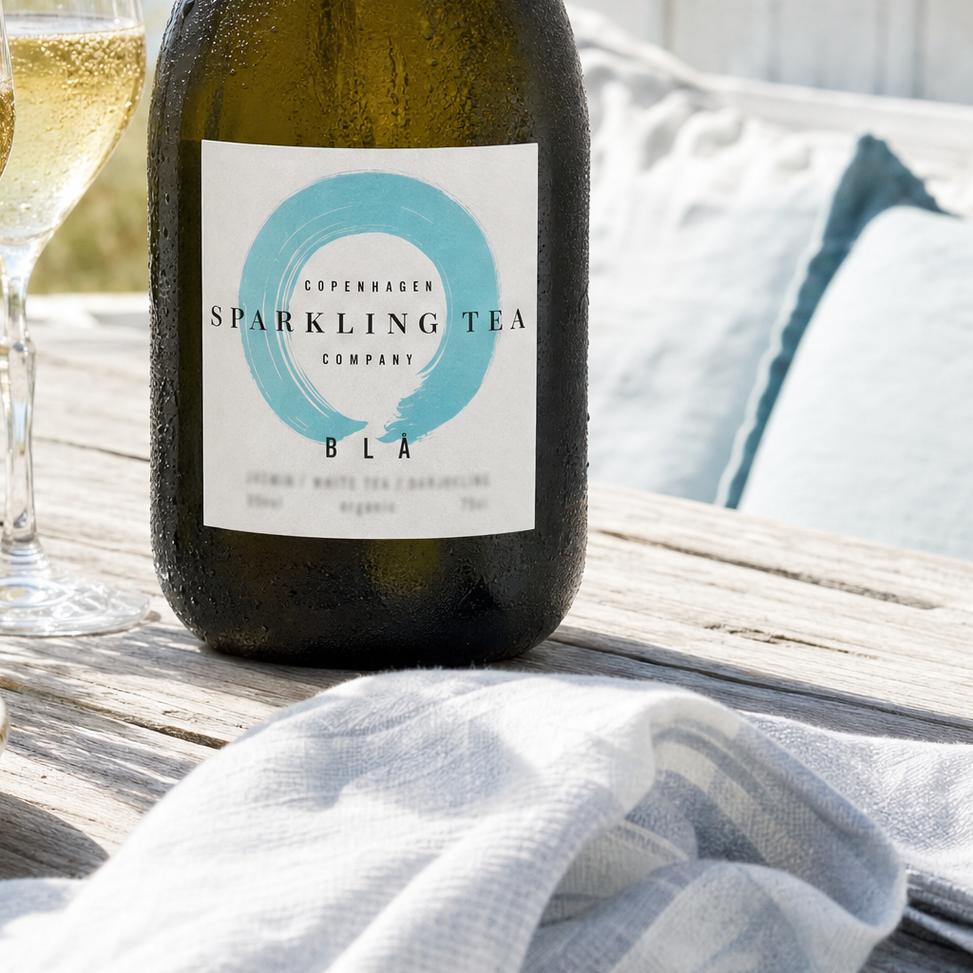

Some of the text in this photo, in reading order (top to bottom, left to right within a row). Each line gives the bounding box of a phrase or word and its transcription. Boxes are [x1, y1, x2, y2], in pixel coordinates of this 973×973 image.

[304, 279, 433, 293] COPENHAGEN
[210, 305, 526, 335] SPARKLING TEA
[322, 353, 414, 366] COMPANY
